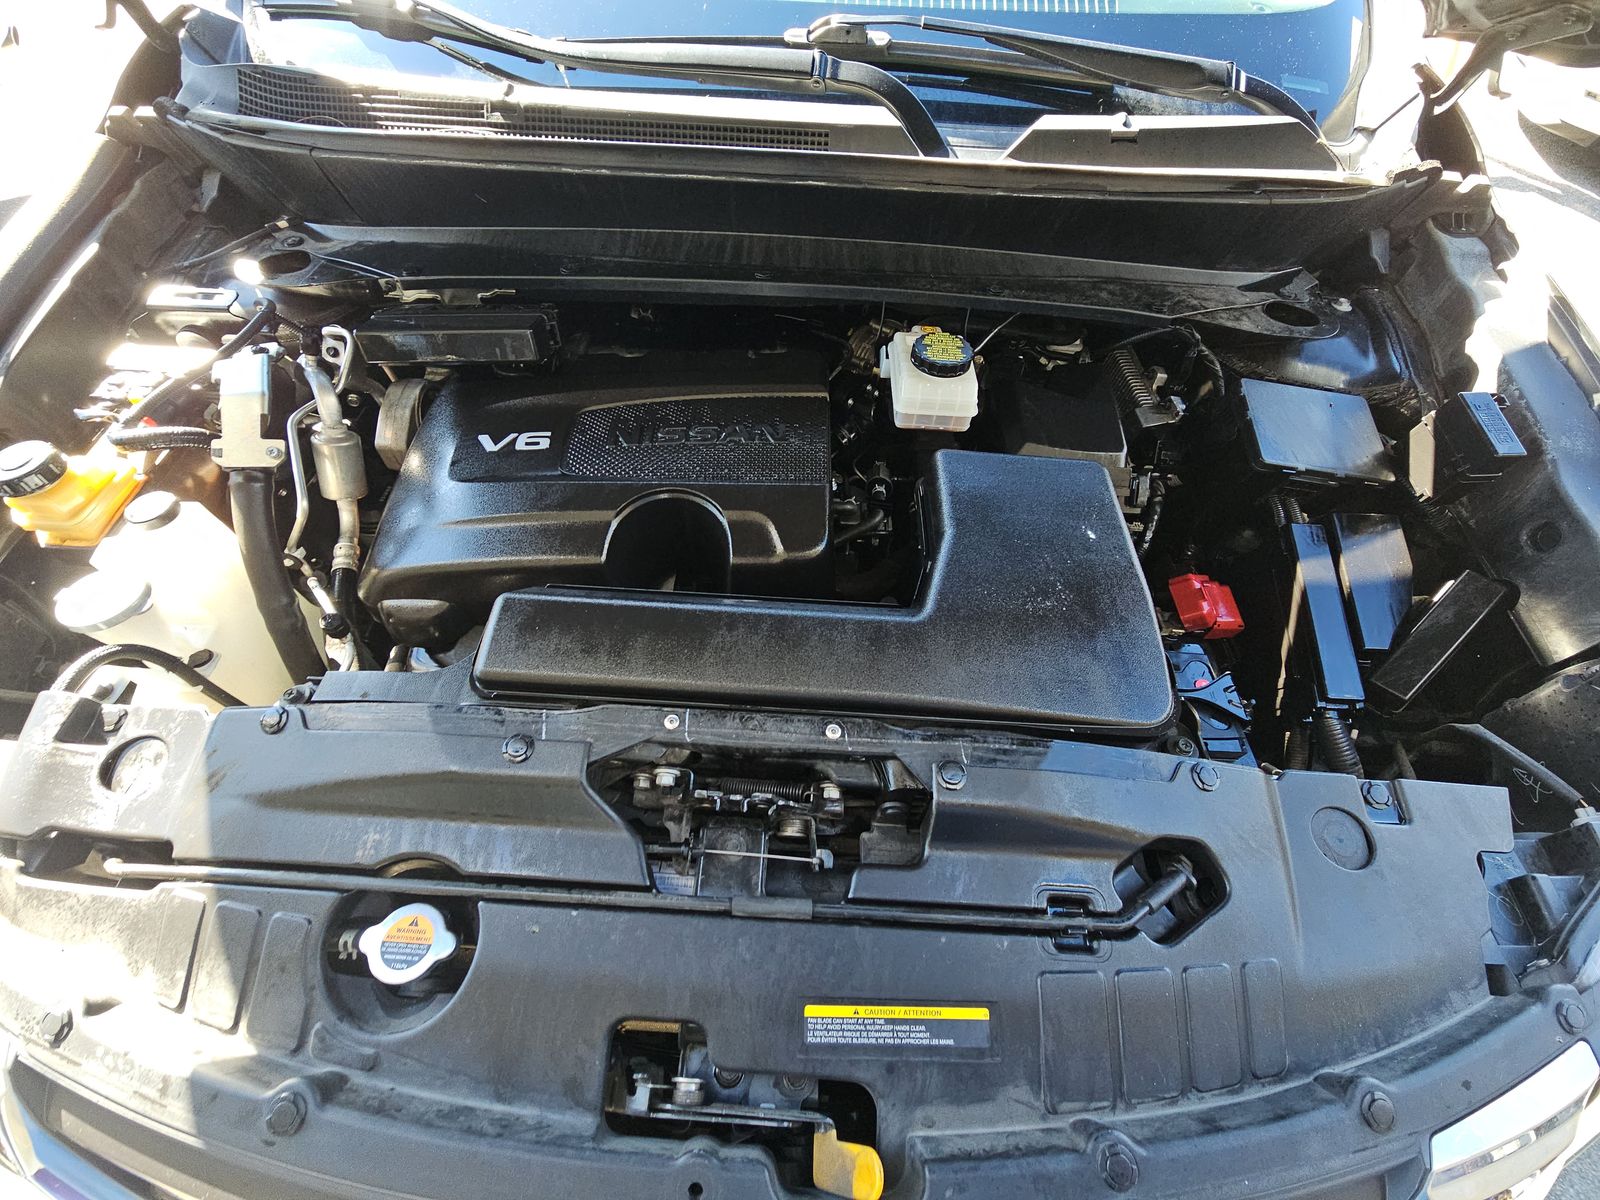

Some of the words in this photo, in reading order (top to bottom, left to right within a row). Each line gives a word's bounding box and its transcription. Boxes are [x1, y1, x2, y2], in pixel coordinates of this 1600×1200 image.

[478, 431, 551, 452] V6
[607, 418, 787, 447] NISSAN
[864, 1008, 896, 1016] CAUTION
